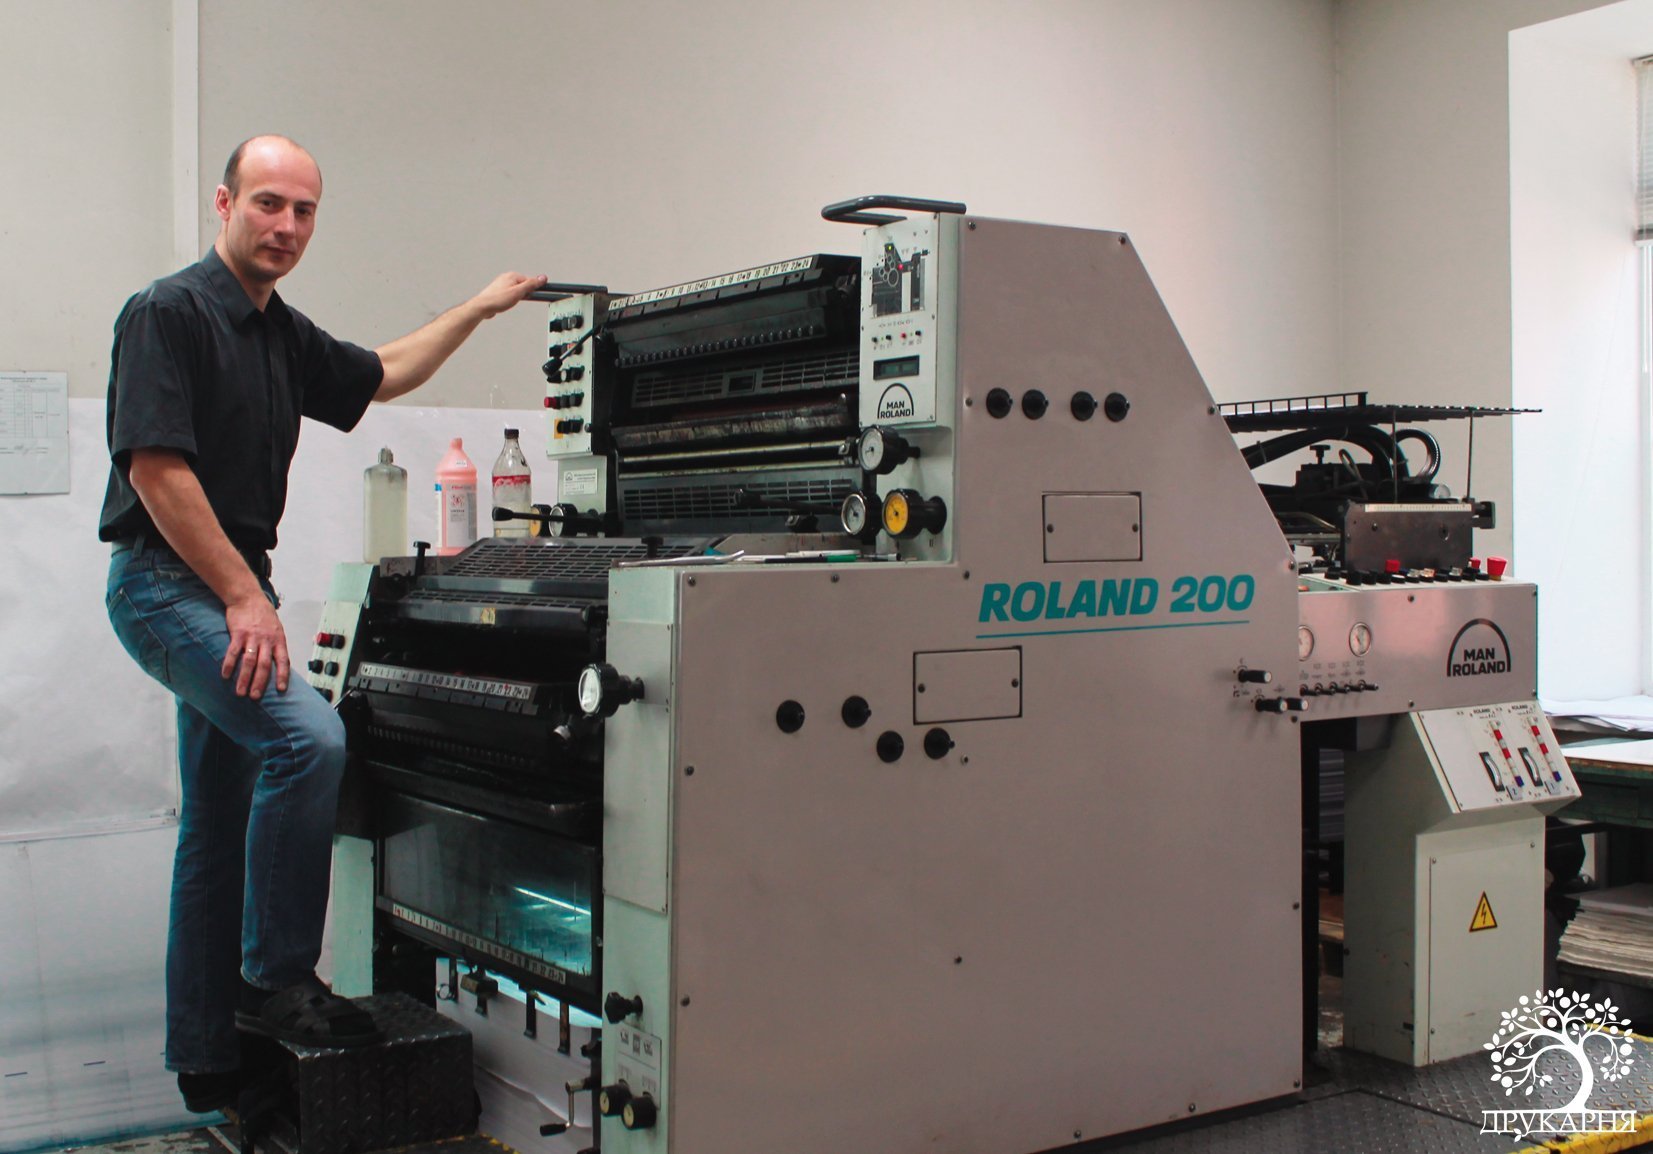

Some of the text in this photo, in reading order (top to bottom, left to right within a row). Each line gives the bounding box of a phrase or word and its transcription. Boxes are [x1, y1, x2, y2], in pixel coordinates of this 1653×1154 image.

[790, 261, 798, 270] 23
[886, 400, 905, 410] MAN
[880, 408, 911, 419] ROLAND
[978, 574, 1255, 622] ROLAND 200
[1463, 647, 1495, 662] MAN
[1452, 660, 1506, 677] ROLAND
